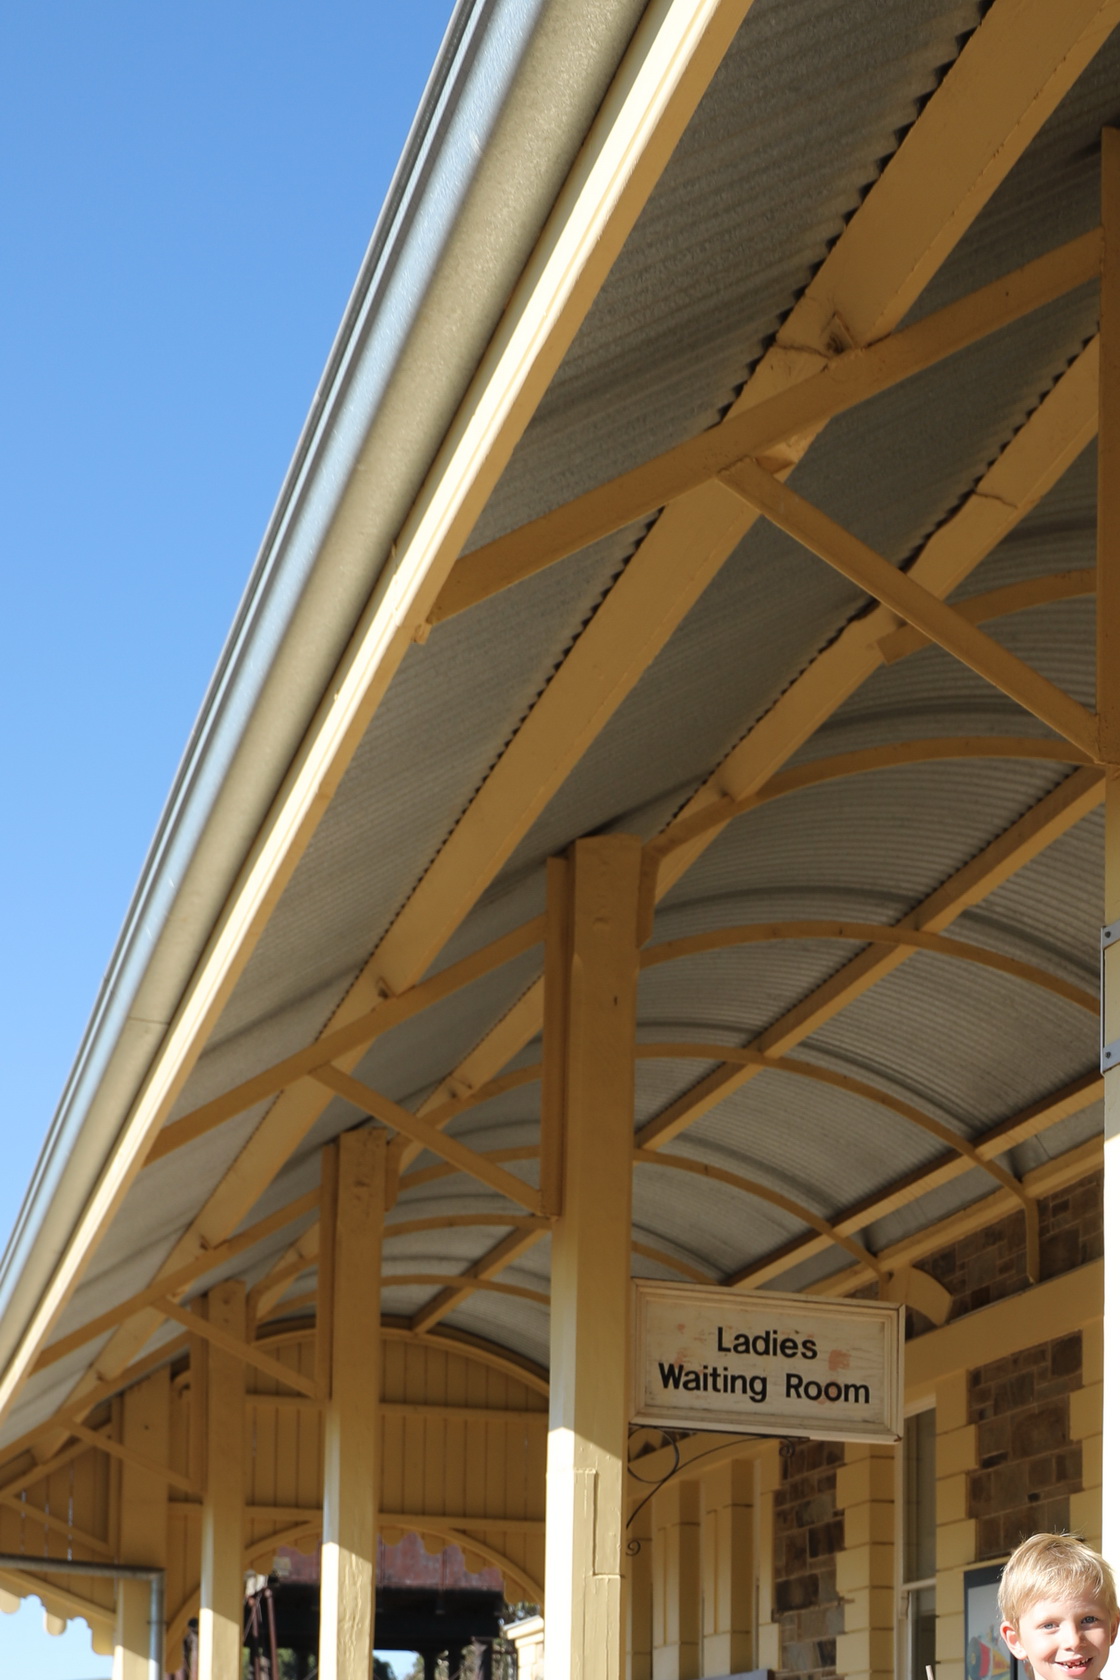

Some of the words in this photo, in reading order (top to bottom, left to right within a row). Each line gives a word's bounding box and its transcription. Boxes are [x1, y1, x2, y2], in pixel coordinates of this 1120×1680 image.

[717, 1326, 818, 1360] Ladies
[658, 1362, 768, 1403] Waiting
[785, 1372, 871, 1404] Room
